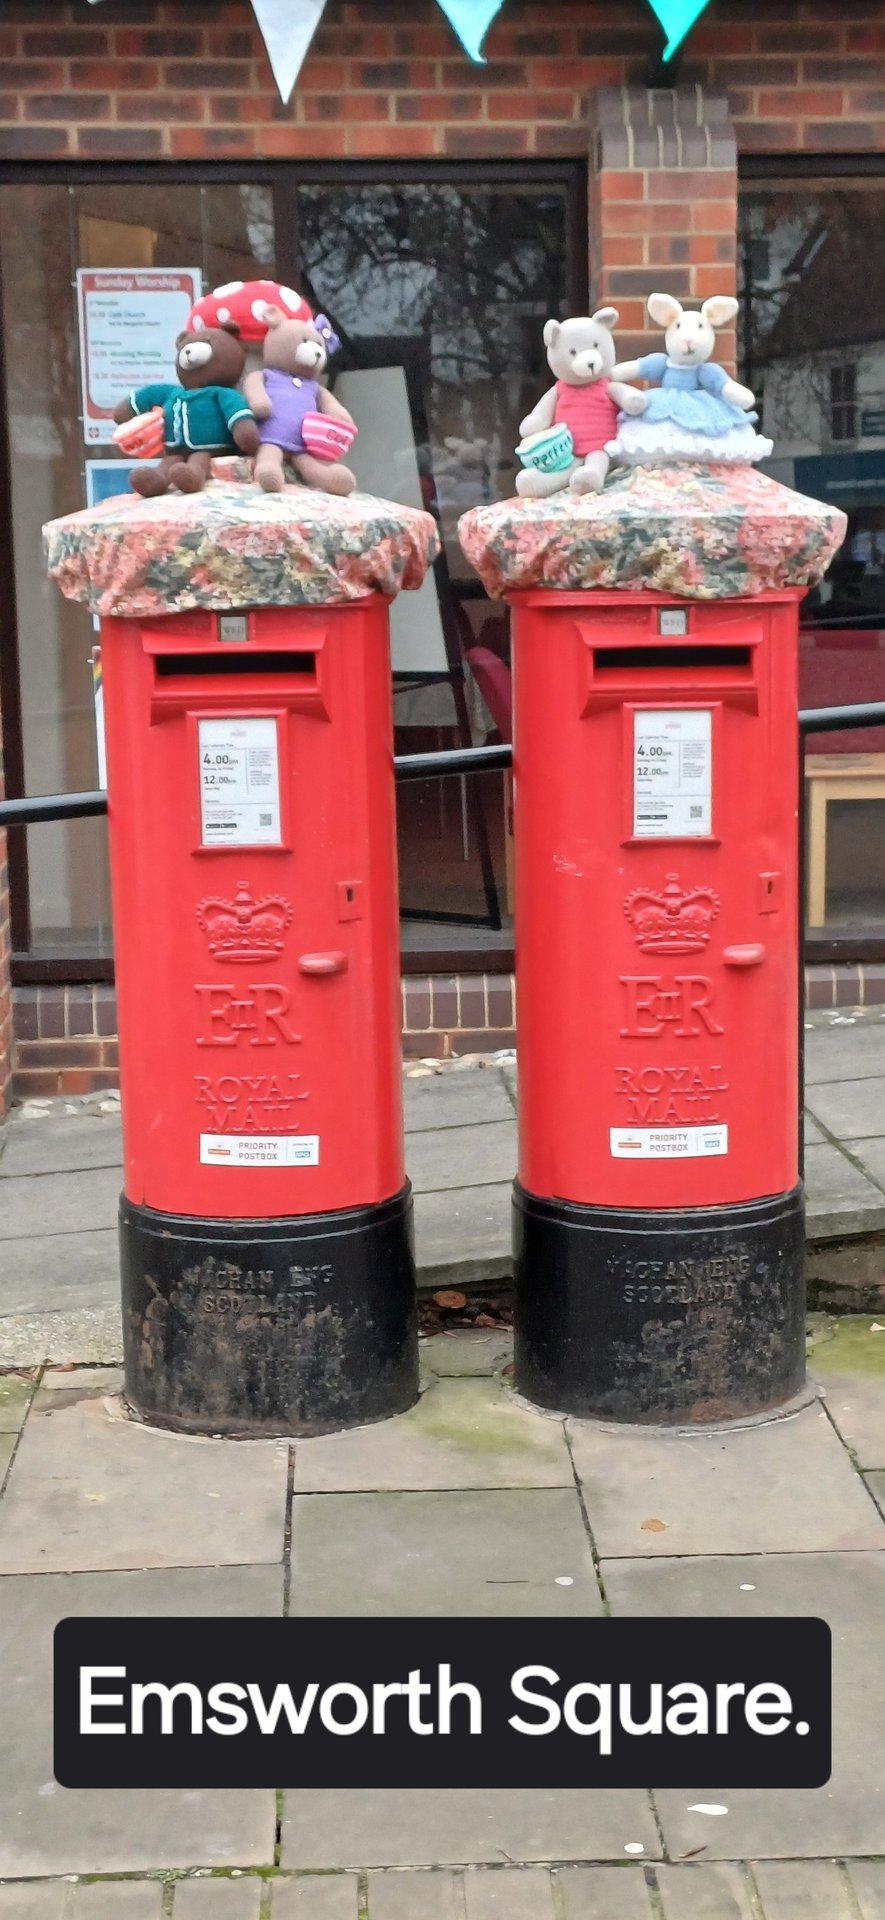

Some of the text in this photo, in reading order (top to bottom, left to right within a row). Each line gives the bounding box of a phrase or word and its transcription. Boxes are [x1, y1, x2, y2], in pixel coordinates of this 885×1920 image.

[94, 275, 180, 291] Sunday Worship
[615, 1065, 730, 1095] ROYAL
[193, 1074, 310, 1103] ROYAL
[626, 1095, 720, 1125] MAIL
[205, 1105, 301, 1134] MAIL
[649, 1133, 688, 1142] PRIORITY
[238, 1142, 278, 1150] PRIORITY
[649, 1144, 688, 1152] POSTBOX
[238, 1152, 278, 1160] POSTBOX
